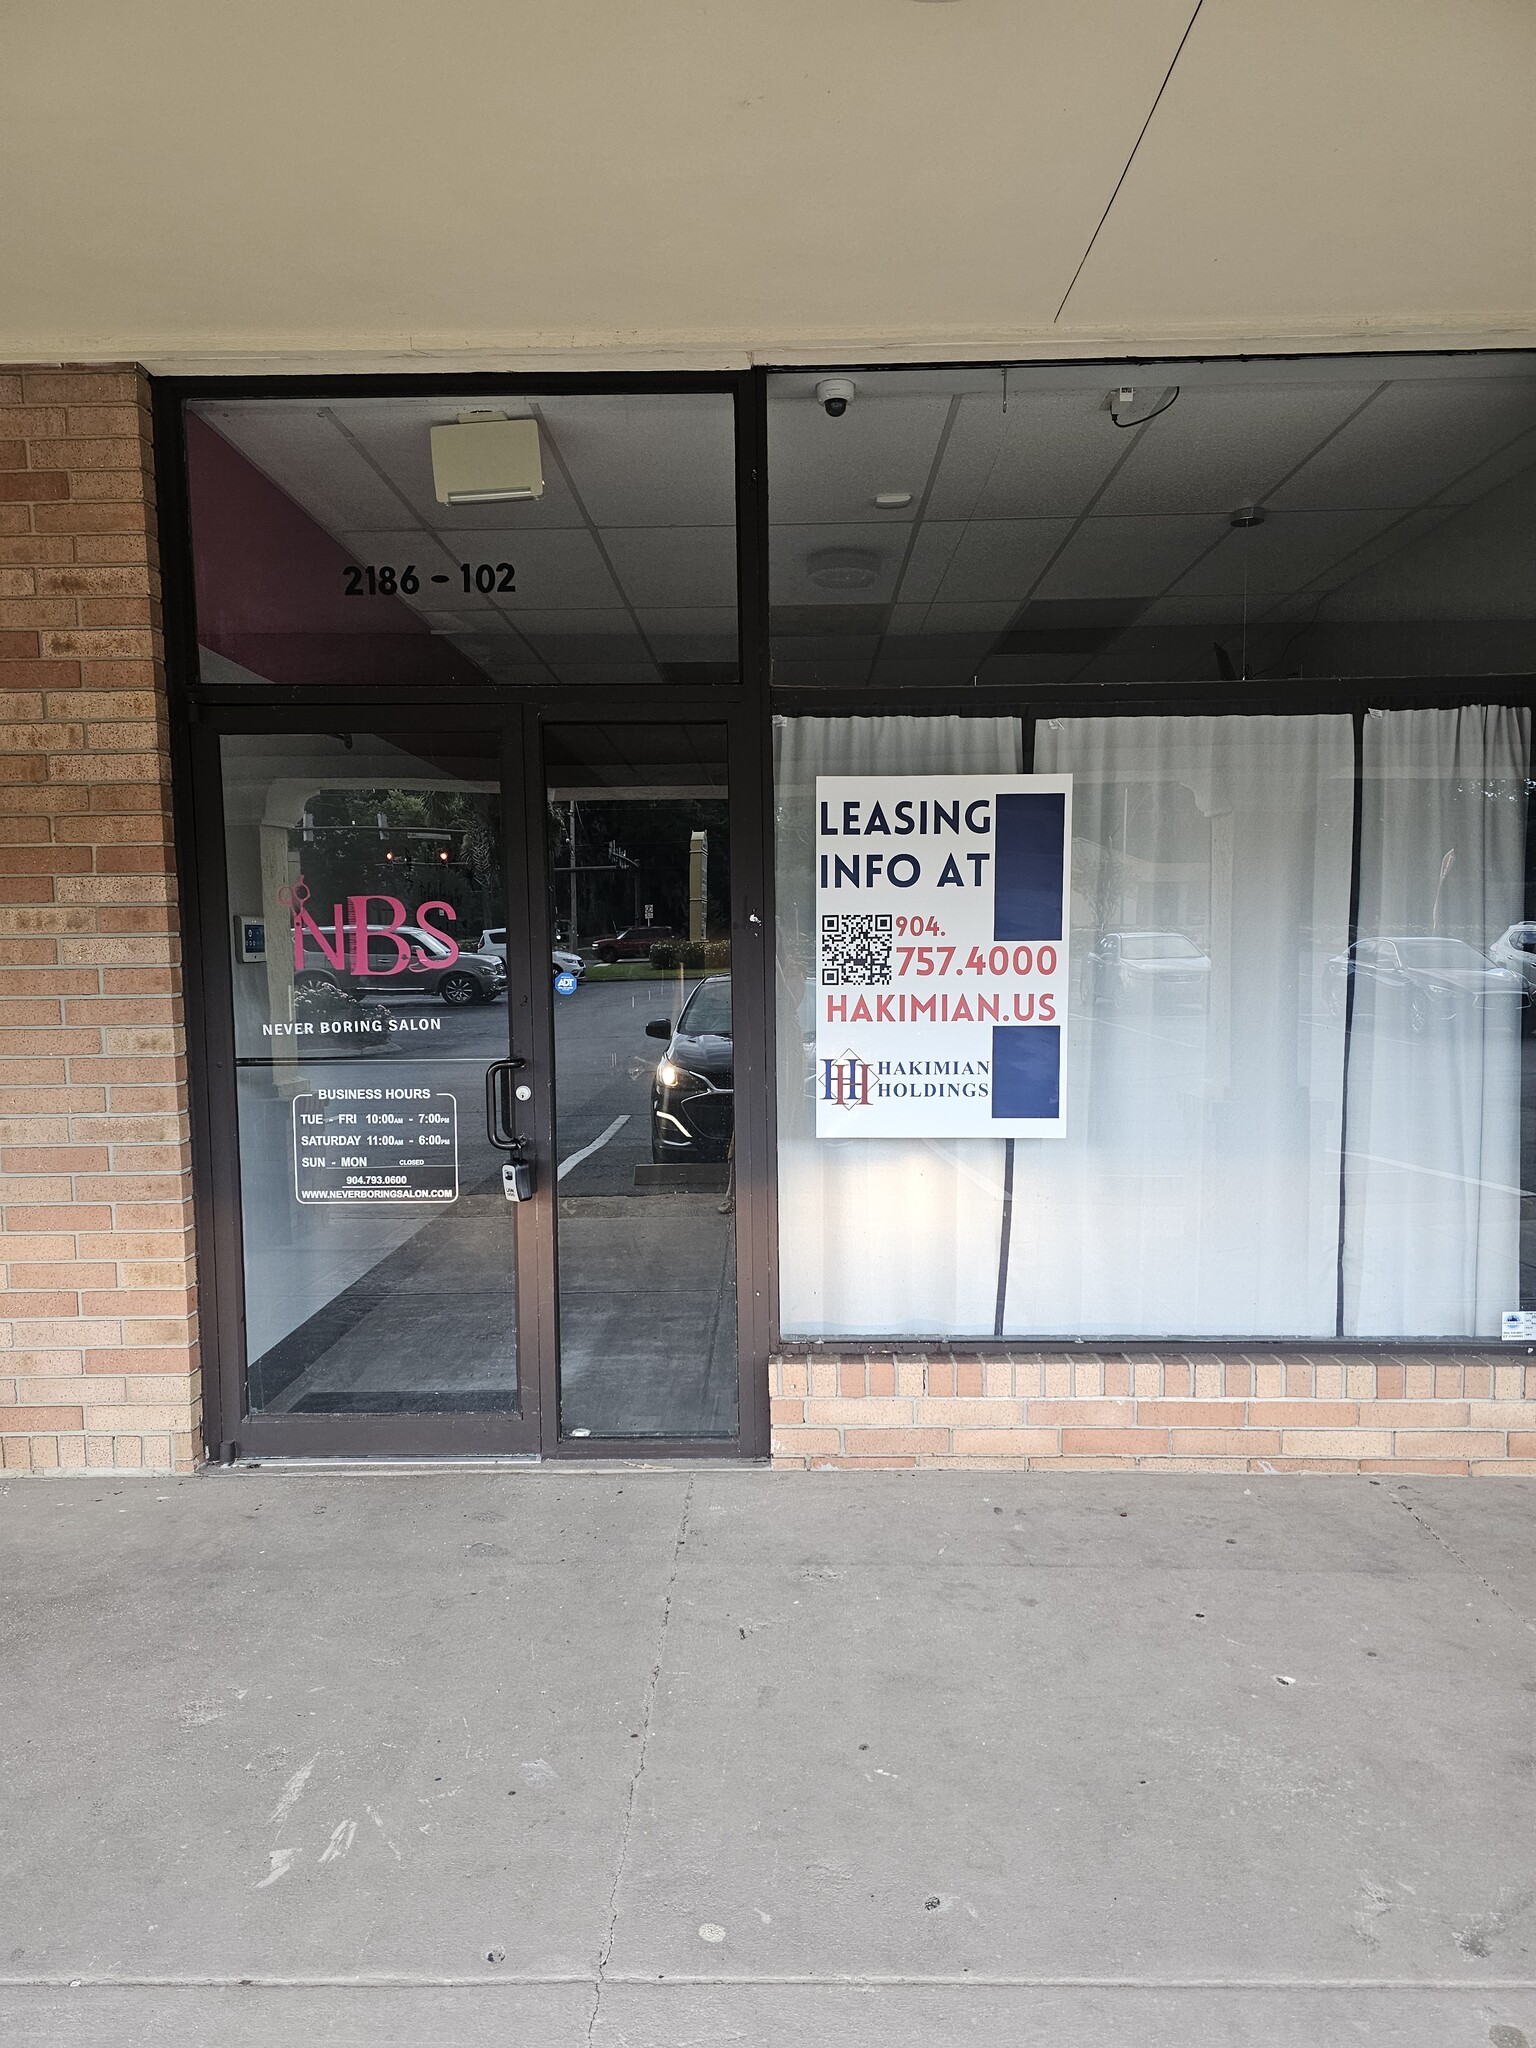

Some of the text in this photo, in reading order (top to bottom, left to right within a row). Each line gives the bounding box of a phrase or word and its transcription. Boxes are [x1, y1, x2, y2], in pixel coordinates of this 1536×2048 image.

[343, 565, 420, 596] 2186
[460, 563, 516, 594] 102
[820, 800, 992, 836] LEASING
[820, 852, 991, 889] INFO AT
[895, 915, 946, 937] 904.
[293, 895, 459, 976] NBS
[896, 945, 1058, 976] 757.4000
[827, 993, 1057, 1023] HAKIMIAN.US
[262, 1018, 441, 1036] NEVER BORING SALON
[877, 1060, 990, 1076] HAKIMIAN
[318, 1088, 431, 1100] BUSINESS HOURS
[877, 1082, 989, 1098] HOLDINGS
[300, 1114, 324, 1125] TUE
[338, 1113, 357, 1124] FRI
[301, 1135, 361, 1146] SATURDAY
[301, 1157, 326, 1168] SUN
[341, 1156, 368, 1167] MON
[346, 1175, 408, 1185] 904.793.0600
[301, 1189, 453, 1199] WWW.NEVERBORINGSALON.COM
